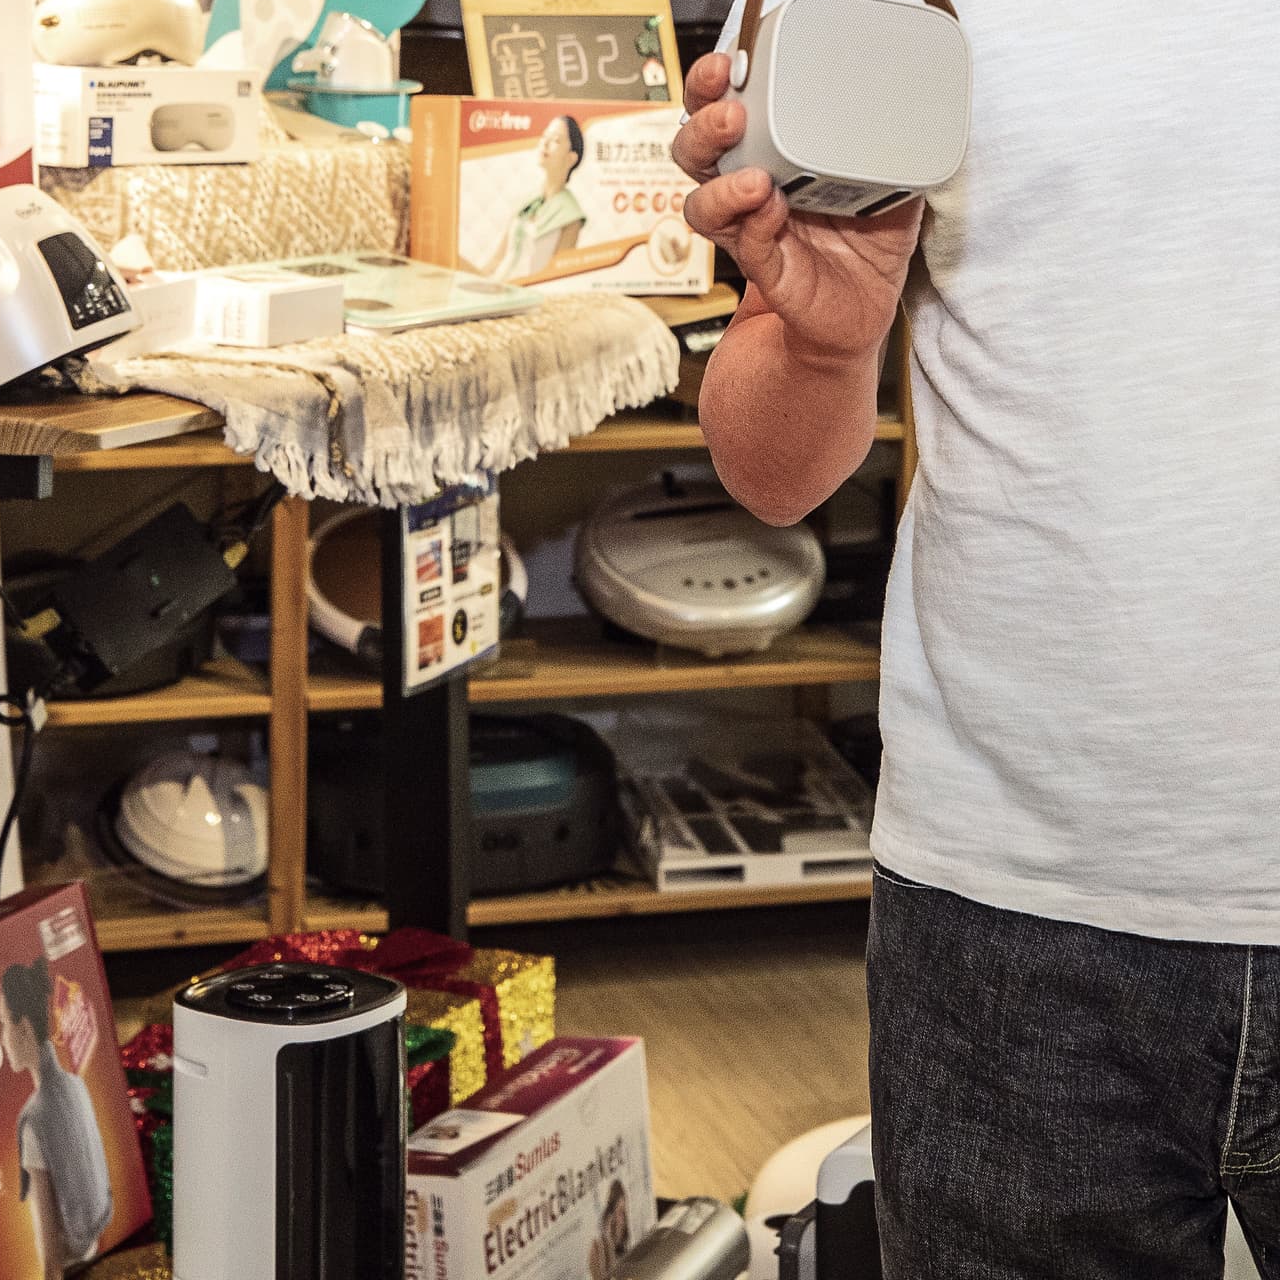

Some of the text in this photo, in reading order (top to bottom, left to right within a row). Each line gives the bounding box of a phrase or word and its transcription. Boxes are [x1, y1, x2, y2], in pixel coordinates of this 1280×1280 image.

[596, 141, 674, 164] 動力式熱
[515, 1132, 561, 1180] Sunlus
